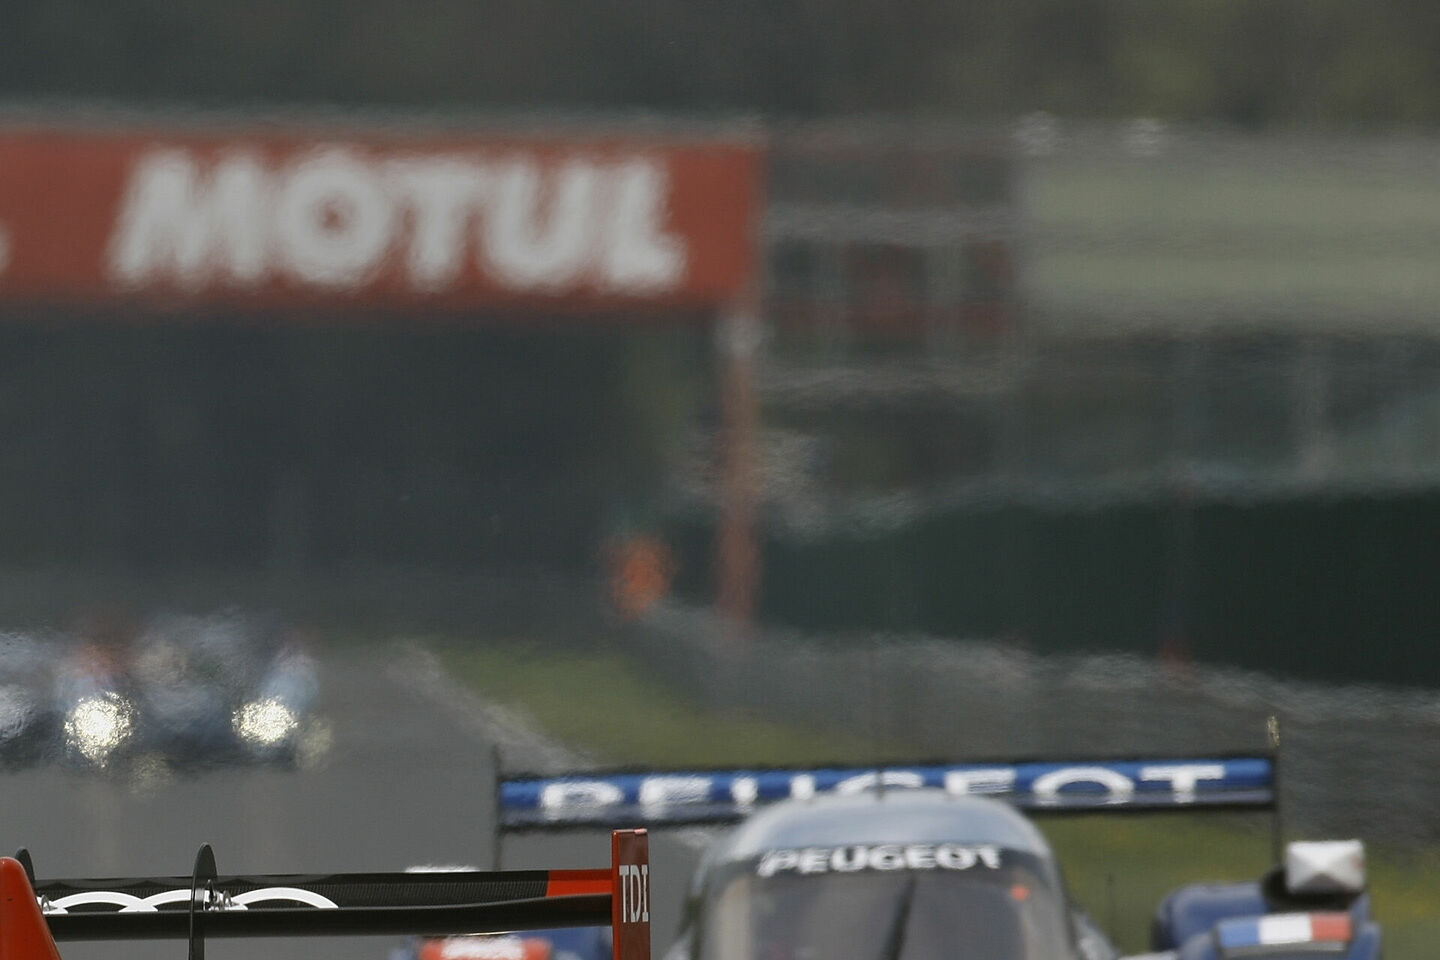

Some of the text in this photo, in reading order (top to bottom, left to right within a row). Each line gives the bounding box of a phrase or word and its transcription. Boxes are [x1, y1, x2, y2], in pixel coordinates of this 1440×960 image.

[108, 147, 687, 290] MOTUL
[757, 846, 1001, 877] PEUGEOT
[619, 865, 648, 923] TDI
